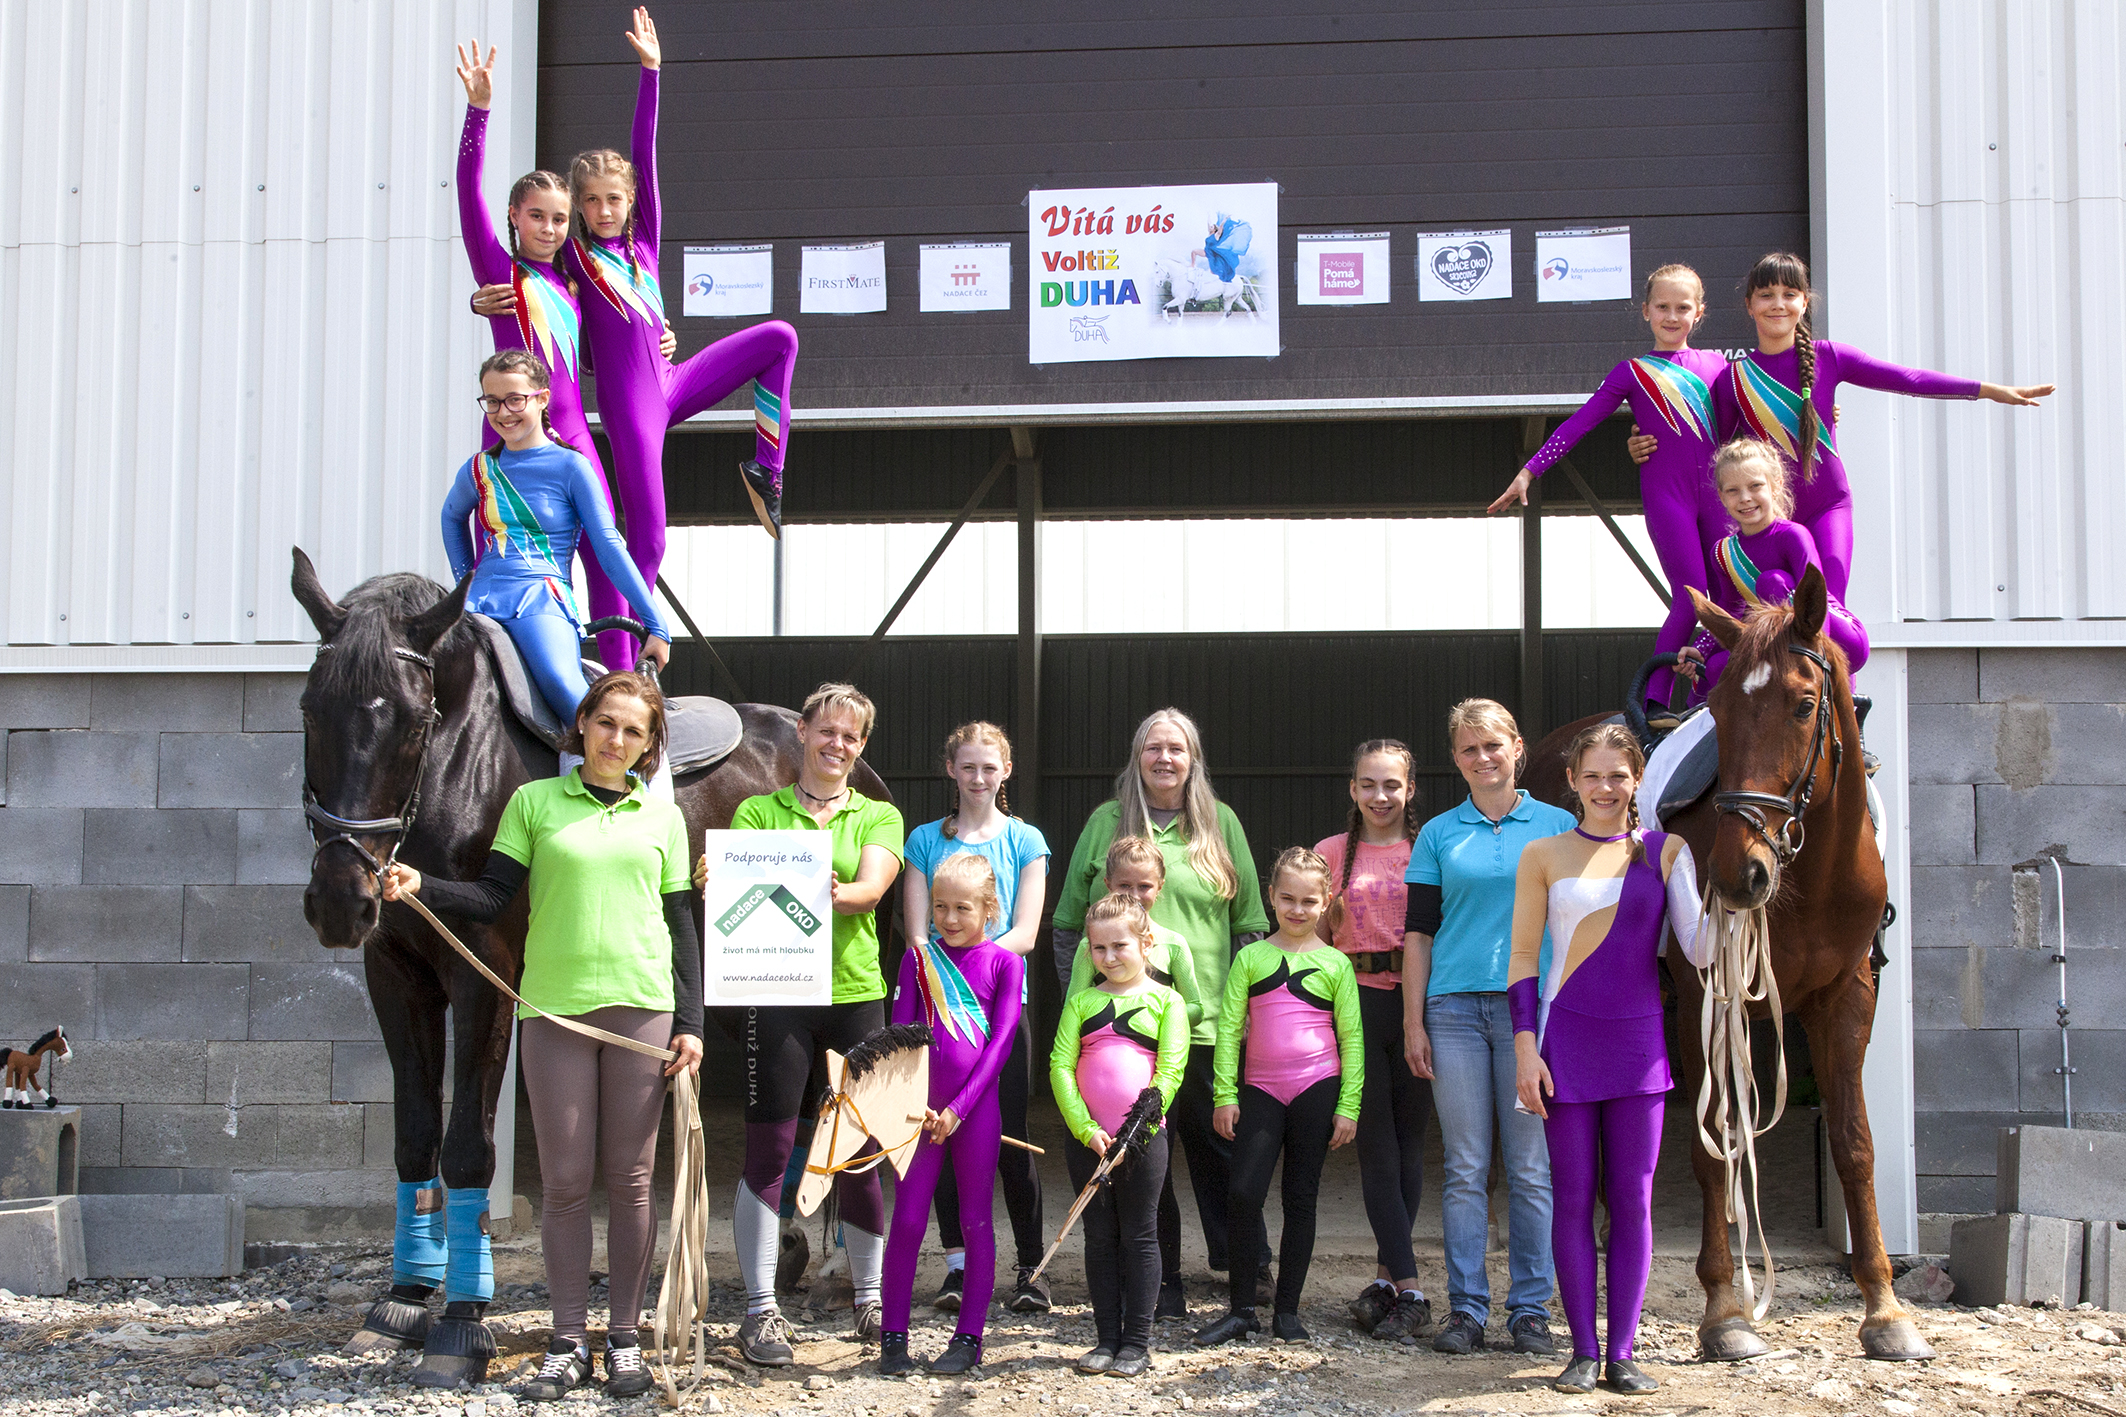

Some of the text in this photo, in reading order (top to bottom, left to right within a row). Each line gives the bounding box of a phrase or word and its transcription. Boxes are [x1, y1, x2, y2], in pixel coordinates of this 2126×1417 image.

[1040, 204, 1175, 237] Vítá vás
[1041, 249, 1119, 272] Voltiž
[1324, 260, 1355, 268] T-Mobile
[1438, 258, 1487, 273] NADACE OKD
[1324, 268, 1355, 278] Pomá
[1570, 265, 1623, 274] Moravskoslezský
[715, 281, 764, 290] Moravskoslezský
[1324, 278, 1357, 289] háme
[974, 289, 988, 297] ČEZ
[1040, 279, 1141, 308] DUHA
[1074, 329, 1104, 342] DUHA
[724, 852, 813, 866] Podporuje nás
[722, 888, 765, 931] nadace
[785, 901, 815, 930] OKD
[722, 946, 815, 954] život má mít hloubku
[722, 973, 814, 982] www.nadaceokd.cz
[747, 1006, 759, 1106] OLTIŽ DUHA
